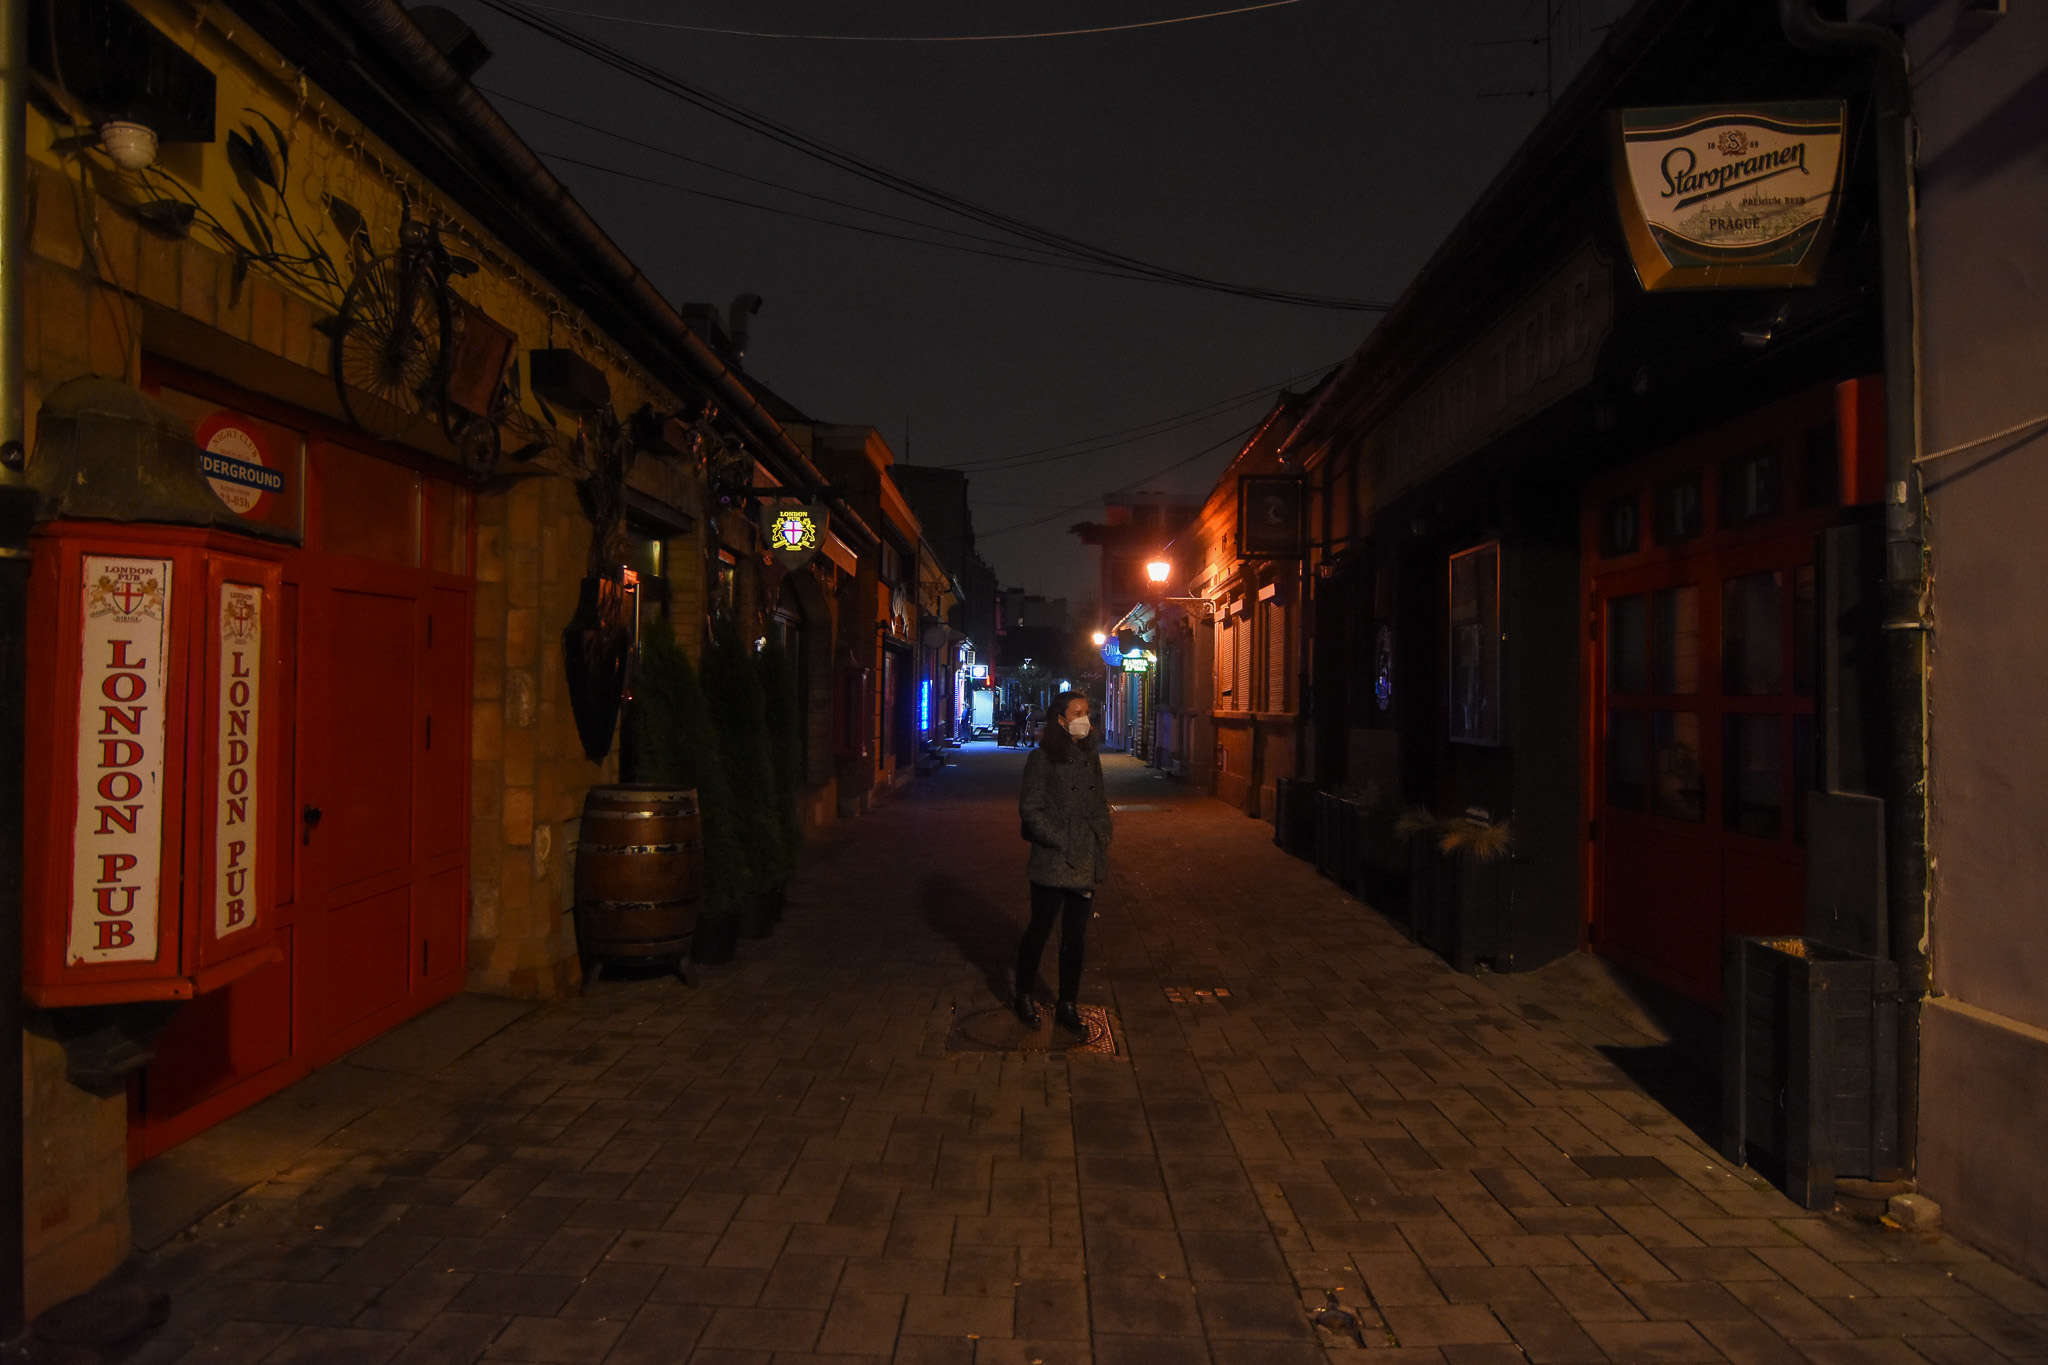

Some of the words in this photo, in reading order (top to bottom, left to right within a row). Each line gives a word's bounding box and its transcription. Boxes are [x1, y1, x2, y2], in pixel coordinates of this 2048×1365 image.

[1707, 142, 1716, 150] 18
[1749, 141, 1759, 149] 69
[1661, 142, 1809, 198] Staropramen
[1742, 197, 1782, 207] PREMIUM
[1784, 196, 1806, 206] BEER
[1709, 218, 1760, 230] PRAGUE
[212, 429, 238, 446] NIGHT
[239, 434, 258, 458] CLUB
[201, 455, 282, 488] DERGROUND
[104, 565, 154, 575] LONDON
[117, 573, 141, 581] PUB
[94, 640, 148, 835] LONDON
[226, 652, 250, 825] LONDON
[225, 841, 248, 927] PUB
[92, 854, 141, 950] PUB
